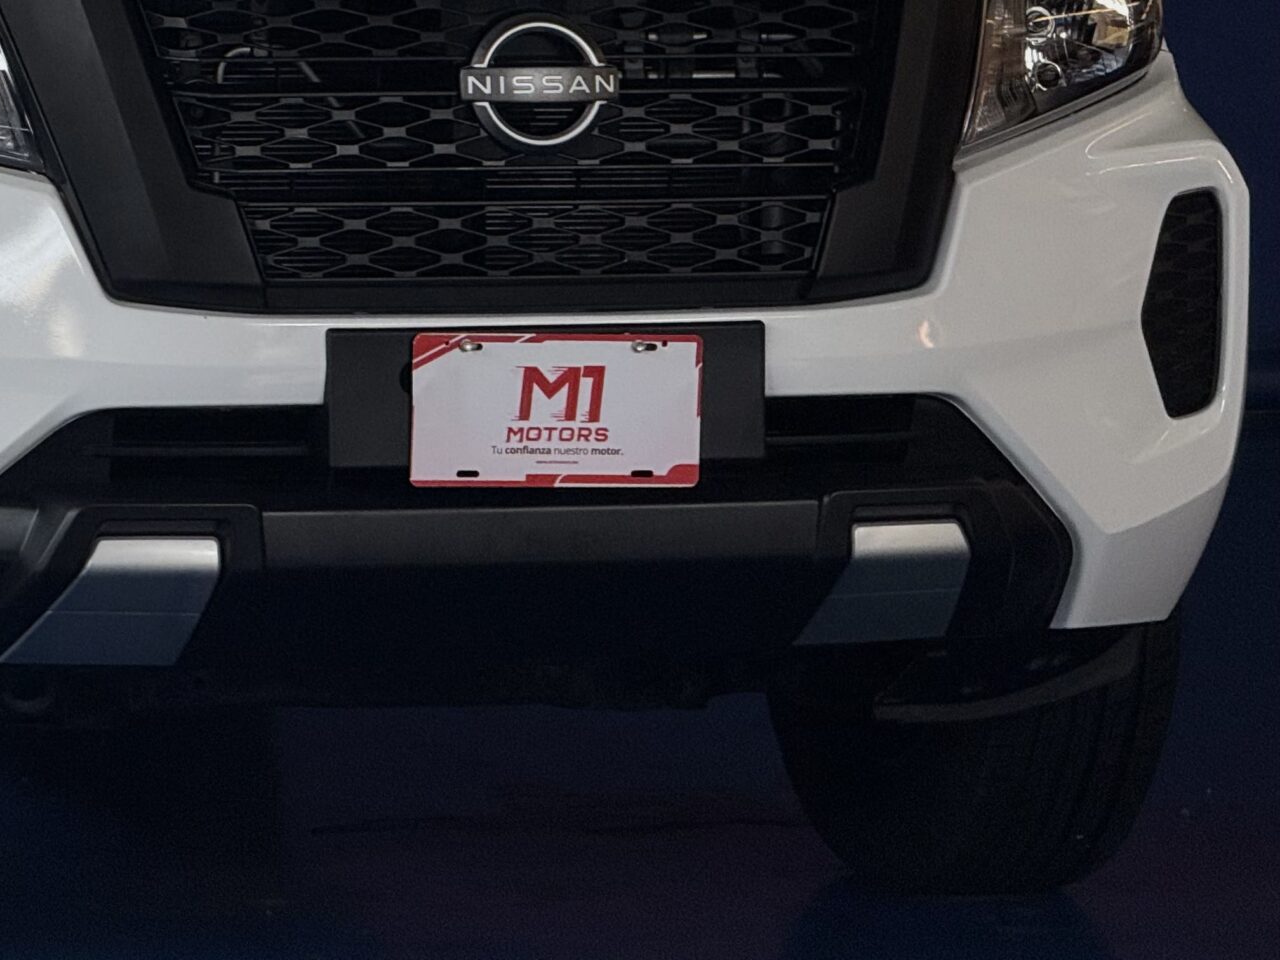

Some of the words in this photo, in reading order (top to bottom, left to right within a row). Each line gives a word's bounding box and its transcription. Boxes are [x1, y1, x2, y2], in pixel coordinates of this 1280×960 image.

[467, 74, 614, 94] NISSAN
[515, 365, 606, 423] M1
[506, 427, 609, 443] MOTORS
[491, 445, 503, 455] Tu
[504, 445, 552, 455] confianza
[553, 447, 589, 456] nuestro
[590, 447, 624, 456] motor.
